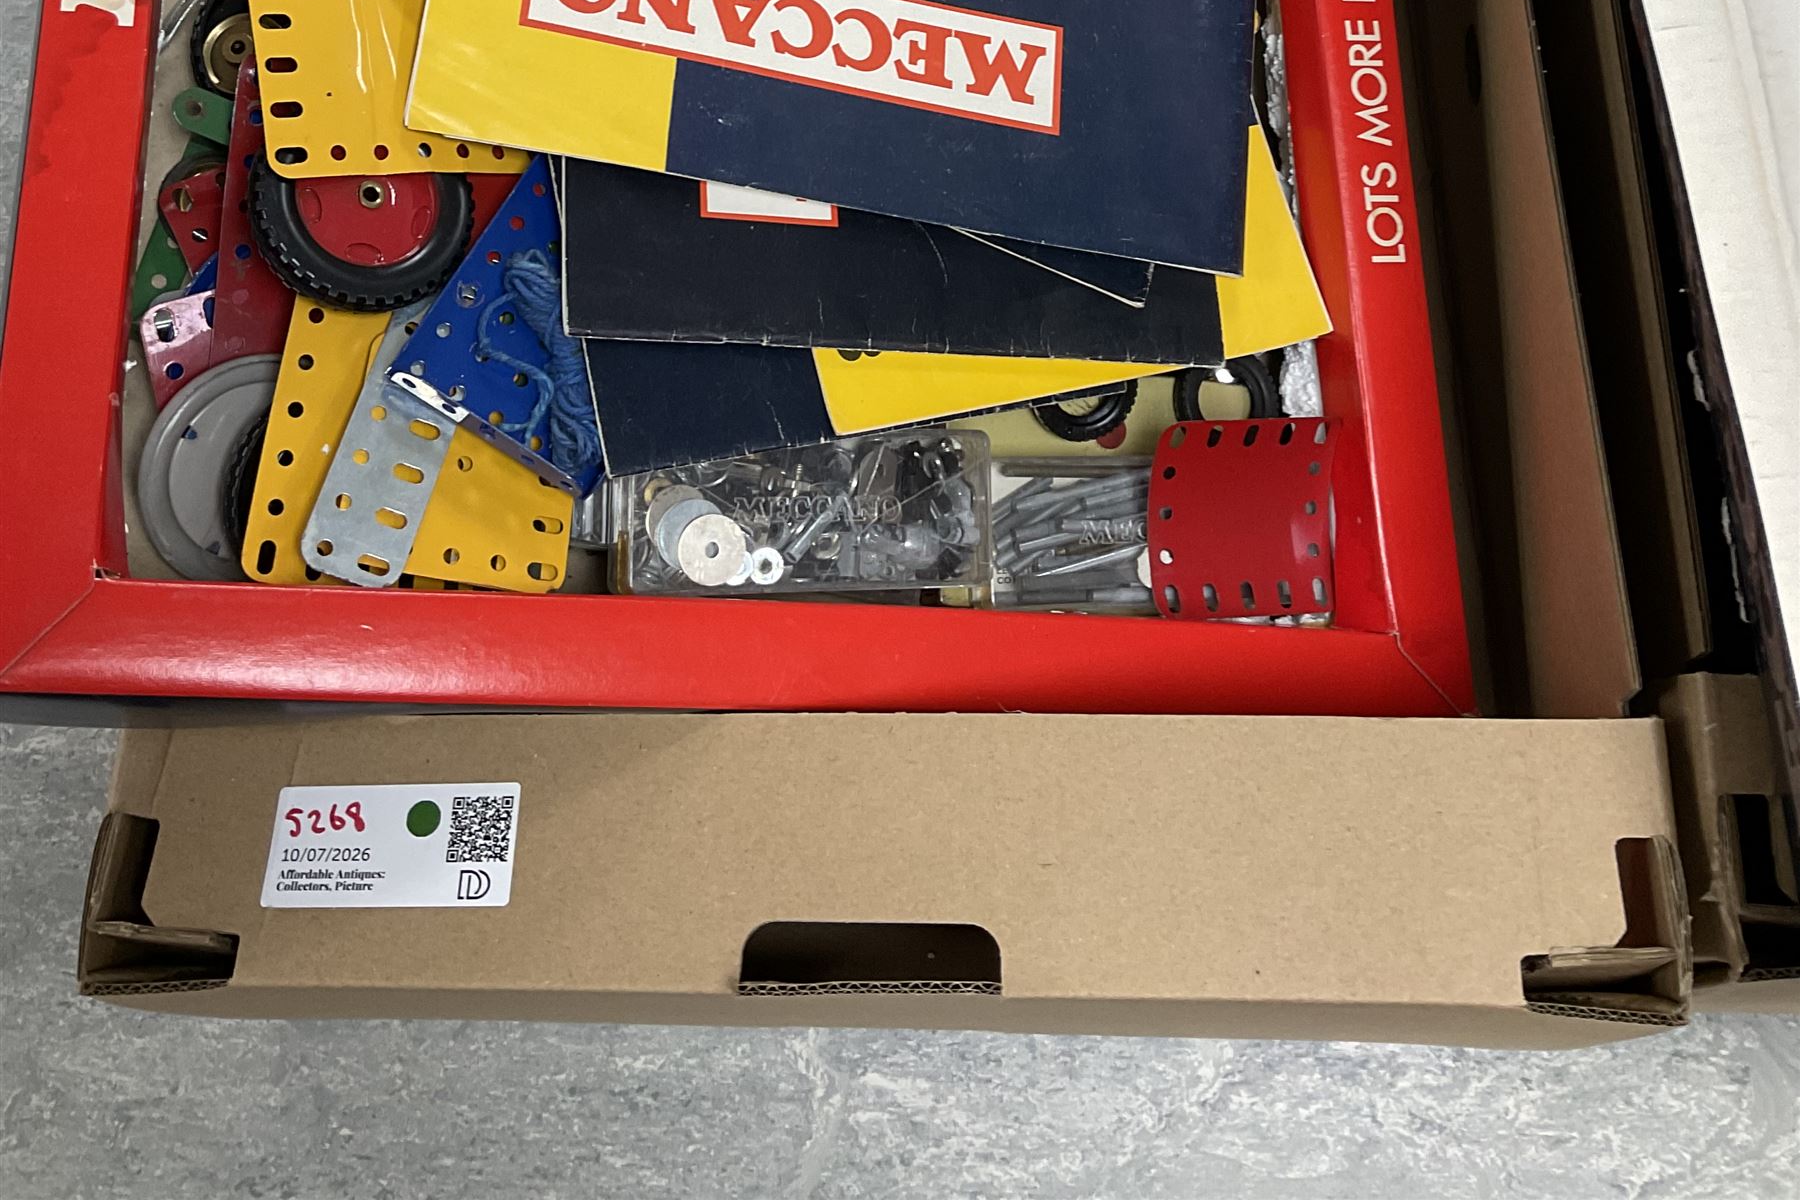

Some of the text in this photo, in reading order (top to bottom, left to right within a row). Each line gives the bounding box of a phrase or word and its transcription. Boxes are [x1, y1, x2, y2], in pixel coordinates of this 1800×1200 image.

[1344, 19, 1393, 147] MORE
[1361, 161, 1407, 263] LOTS
[733, 495, 902, 523] MECCANO
[284, 801, 366, 838] 5268
[280, 847, 372, 863] 10/07/2026
[276, 881, 374, 891] Collectors, Picture
[278, 869, 334, 880] Affordable
